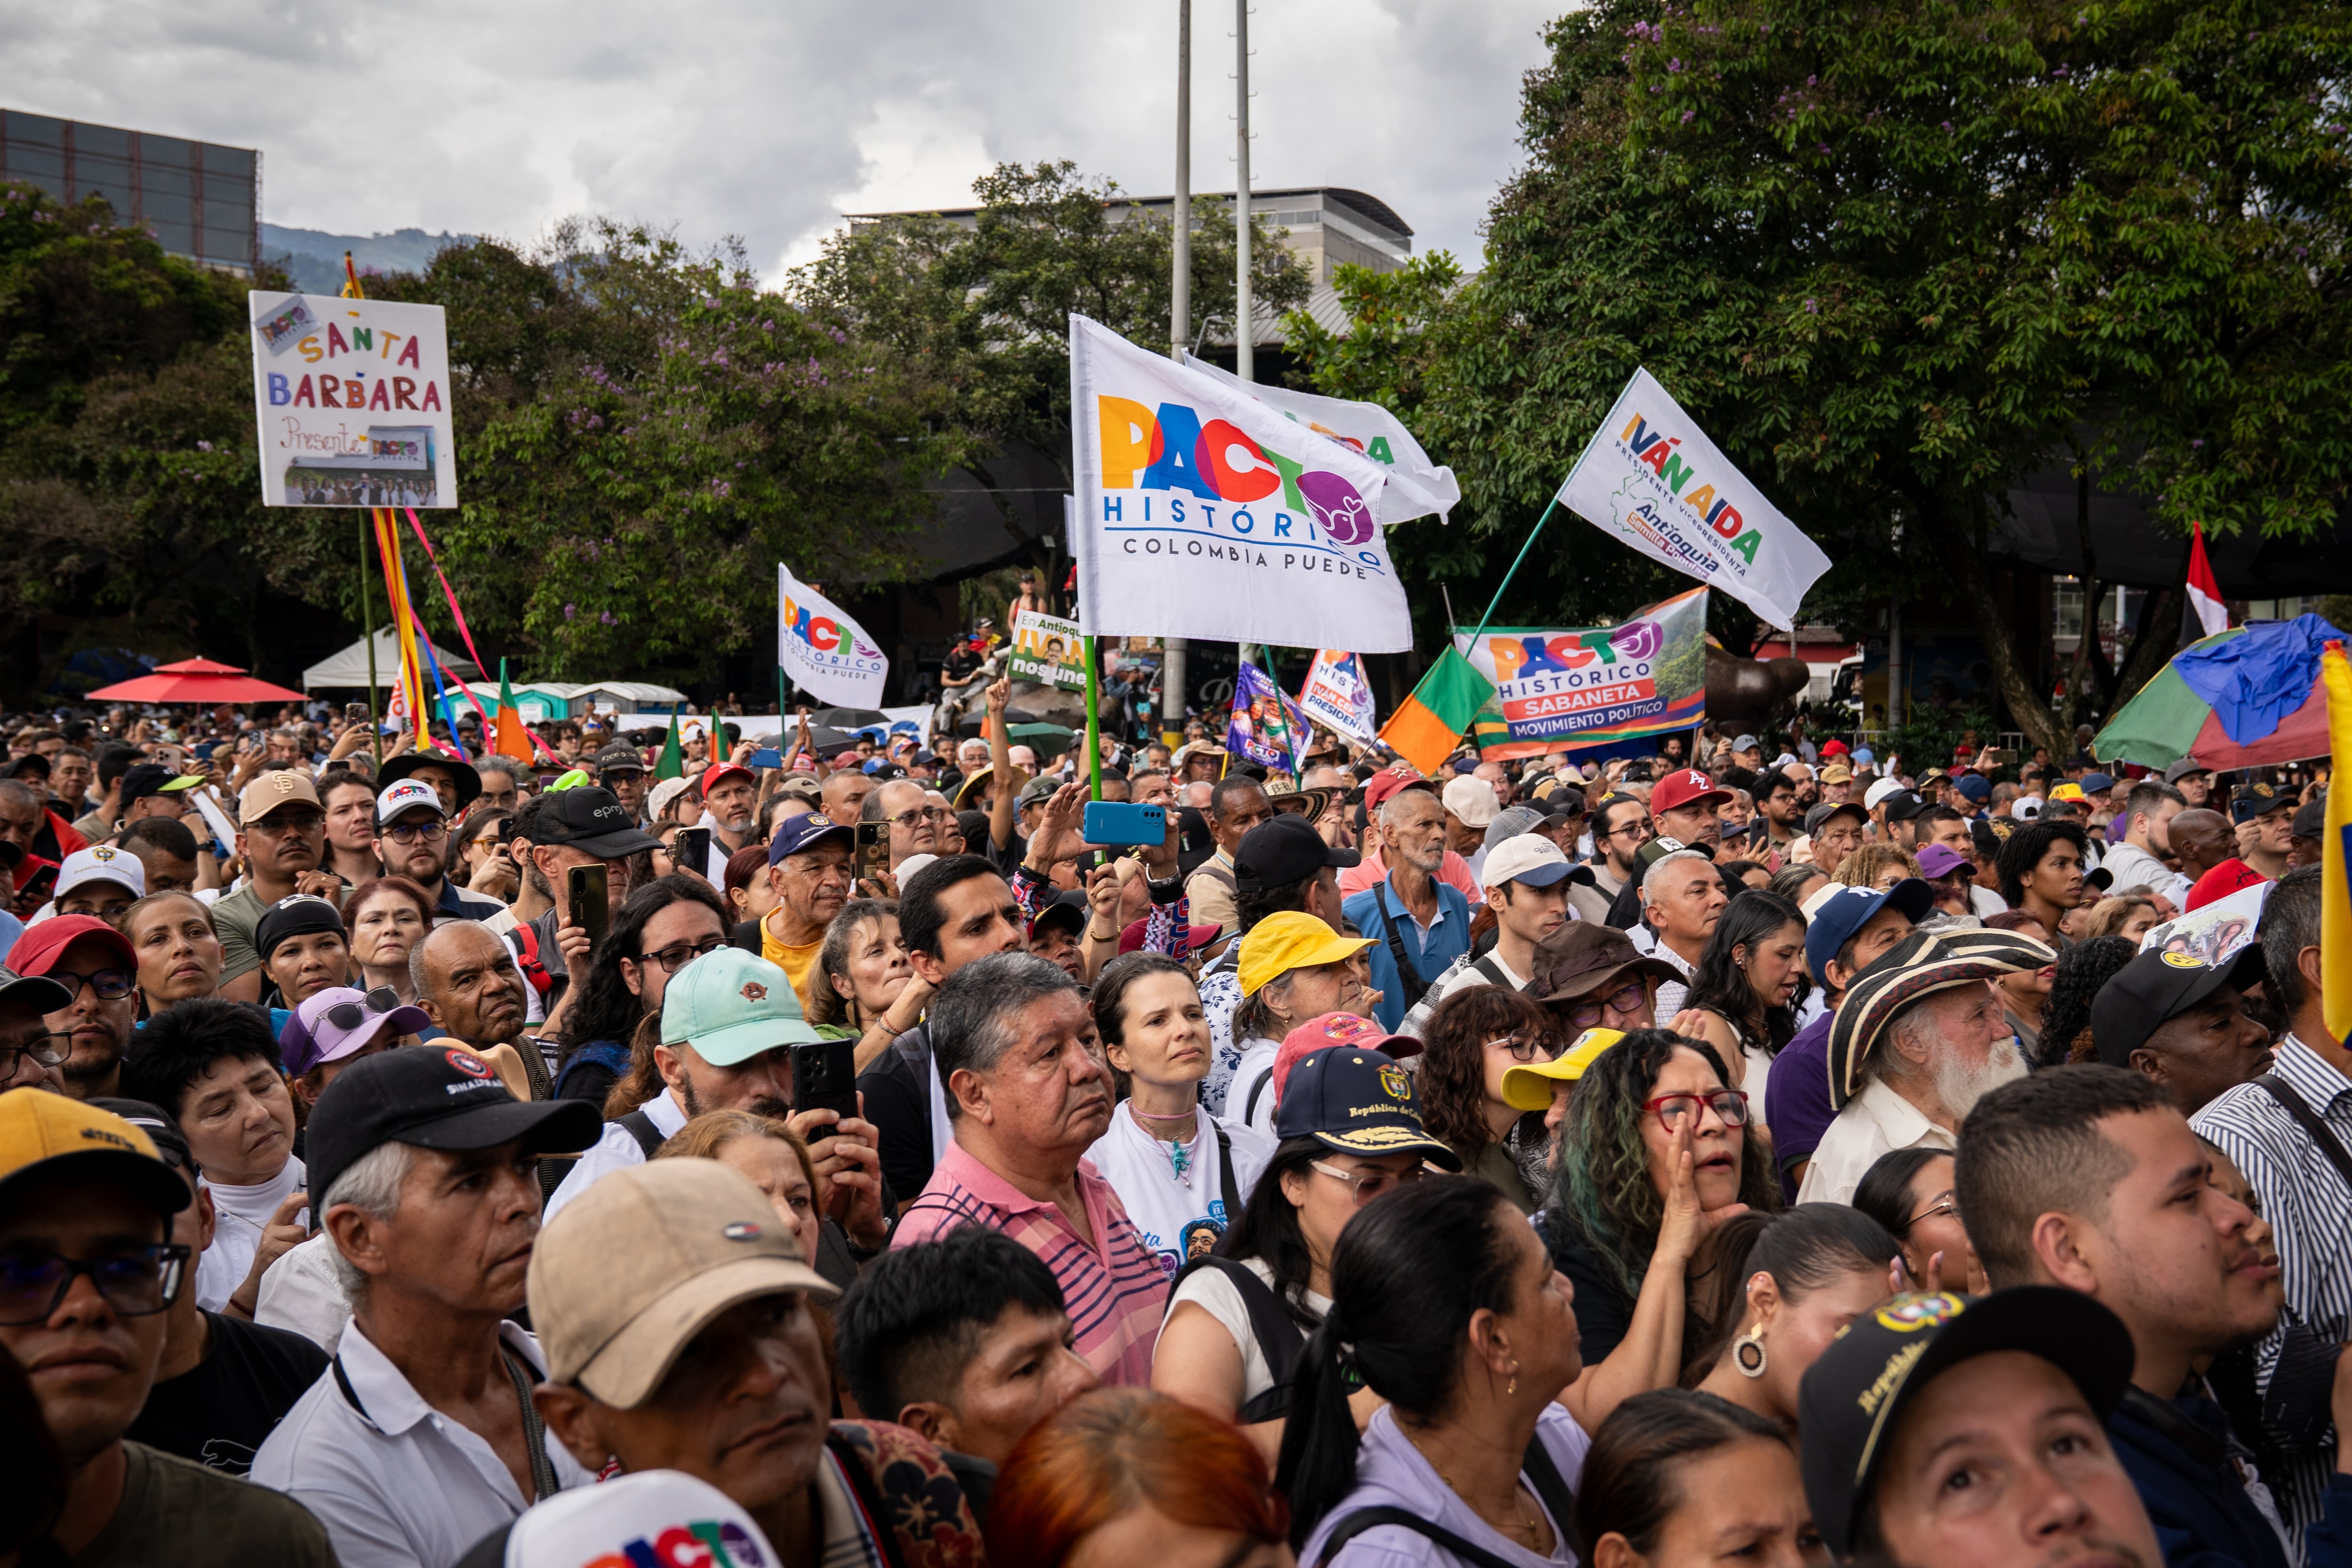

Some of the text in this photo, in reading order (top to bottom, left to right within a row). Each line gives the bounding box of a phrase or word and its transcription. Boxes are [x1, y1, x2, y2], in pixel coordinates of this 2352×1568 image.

[298, 322, 420, 369] SANTA
[268, 372, 442, 412] BARBARA
[279, 416, 362, 454] Presente
[1098, 394, 1374, 546] PACTO
[1620, 412, 1763, 565] IVÁN AIDA
[1615, 440, 1746, 577] PRESIDENTE VICEPRESIDENTA
[1628, 512, 1708, 579] Semilla Popular
[1636, 501, 1720, 573] Antioquia
[1124, 538, 1367, 580] COLOMBIA PUEDE
[1022, 615, 1035, 627] En
[1016, 628, 1086, 668] IVÁN
[1489, 622, 1664, 683] PACTO
[833, 669, 867, 680] PUEDE
[1012, 658, 1087, 685] nos une
[1499, 663, 1650, 699] HISTÓRICO
[1313, 685, 1335, 703] IVÁN
[1525, 684, 1641, 716] SABANETA
[1515, 700, 1663, 737] MOVIMIENTO POLÍTICO
[387, 785, 428, 802] PACTO
[1689, 771, 1709, 790] AZ
[593, 805, 623, 819] epm
[1349, 1103, 1398, 1117] República
[1399, 1106, 1408, 1114] de
